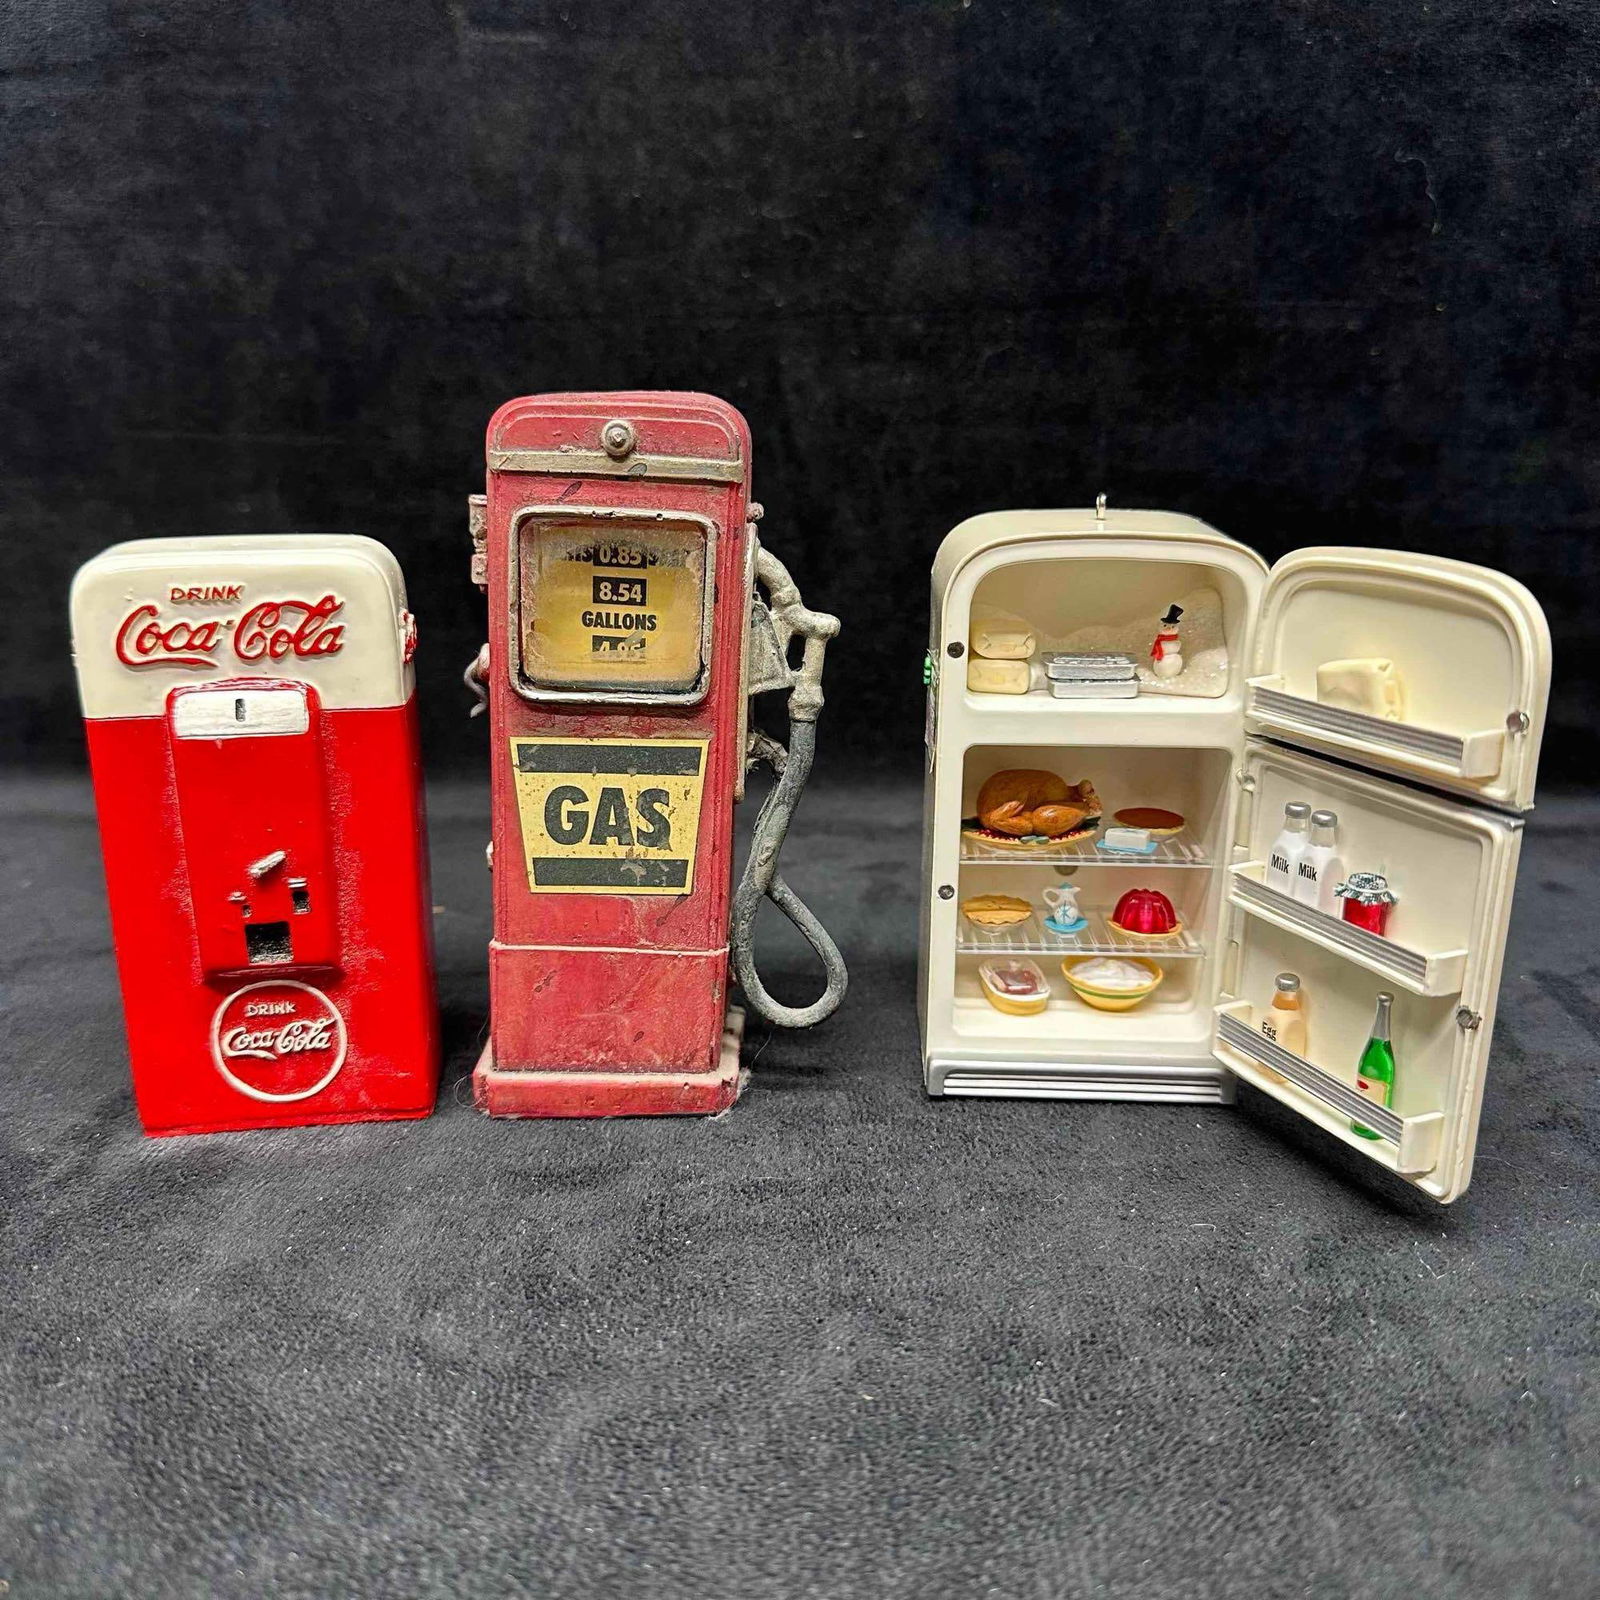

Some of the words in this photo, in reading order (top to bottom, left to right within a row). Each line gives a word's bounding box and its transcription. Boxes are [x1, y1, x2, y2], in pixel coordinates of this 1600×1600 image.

[599, 546, 642, 565] 0.85
[170, 585, 243, 602] DRINK
[599, 582, 643, 603] 8.54
[581, 611, 657, 631] GALLONS
[544, 785, 673, 851] GAS
[1271, 853, 1290, 874] Milk
[1298, 861, 1318, 882] Milk
[245, 1001, 297, 1018] DRINK
